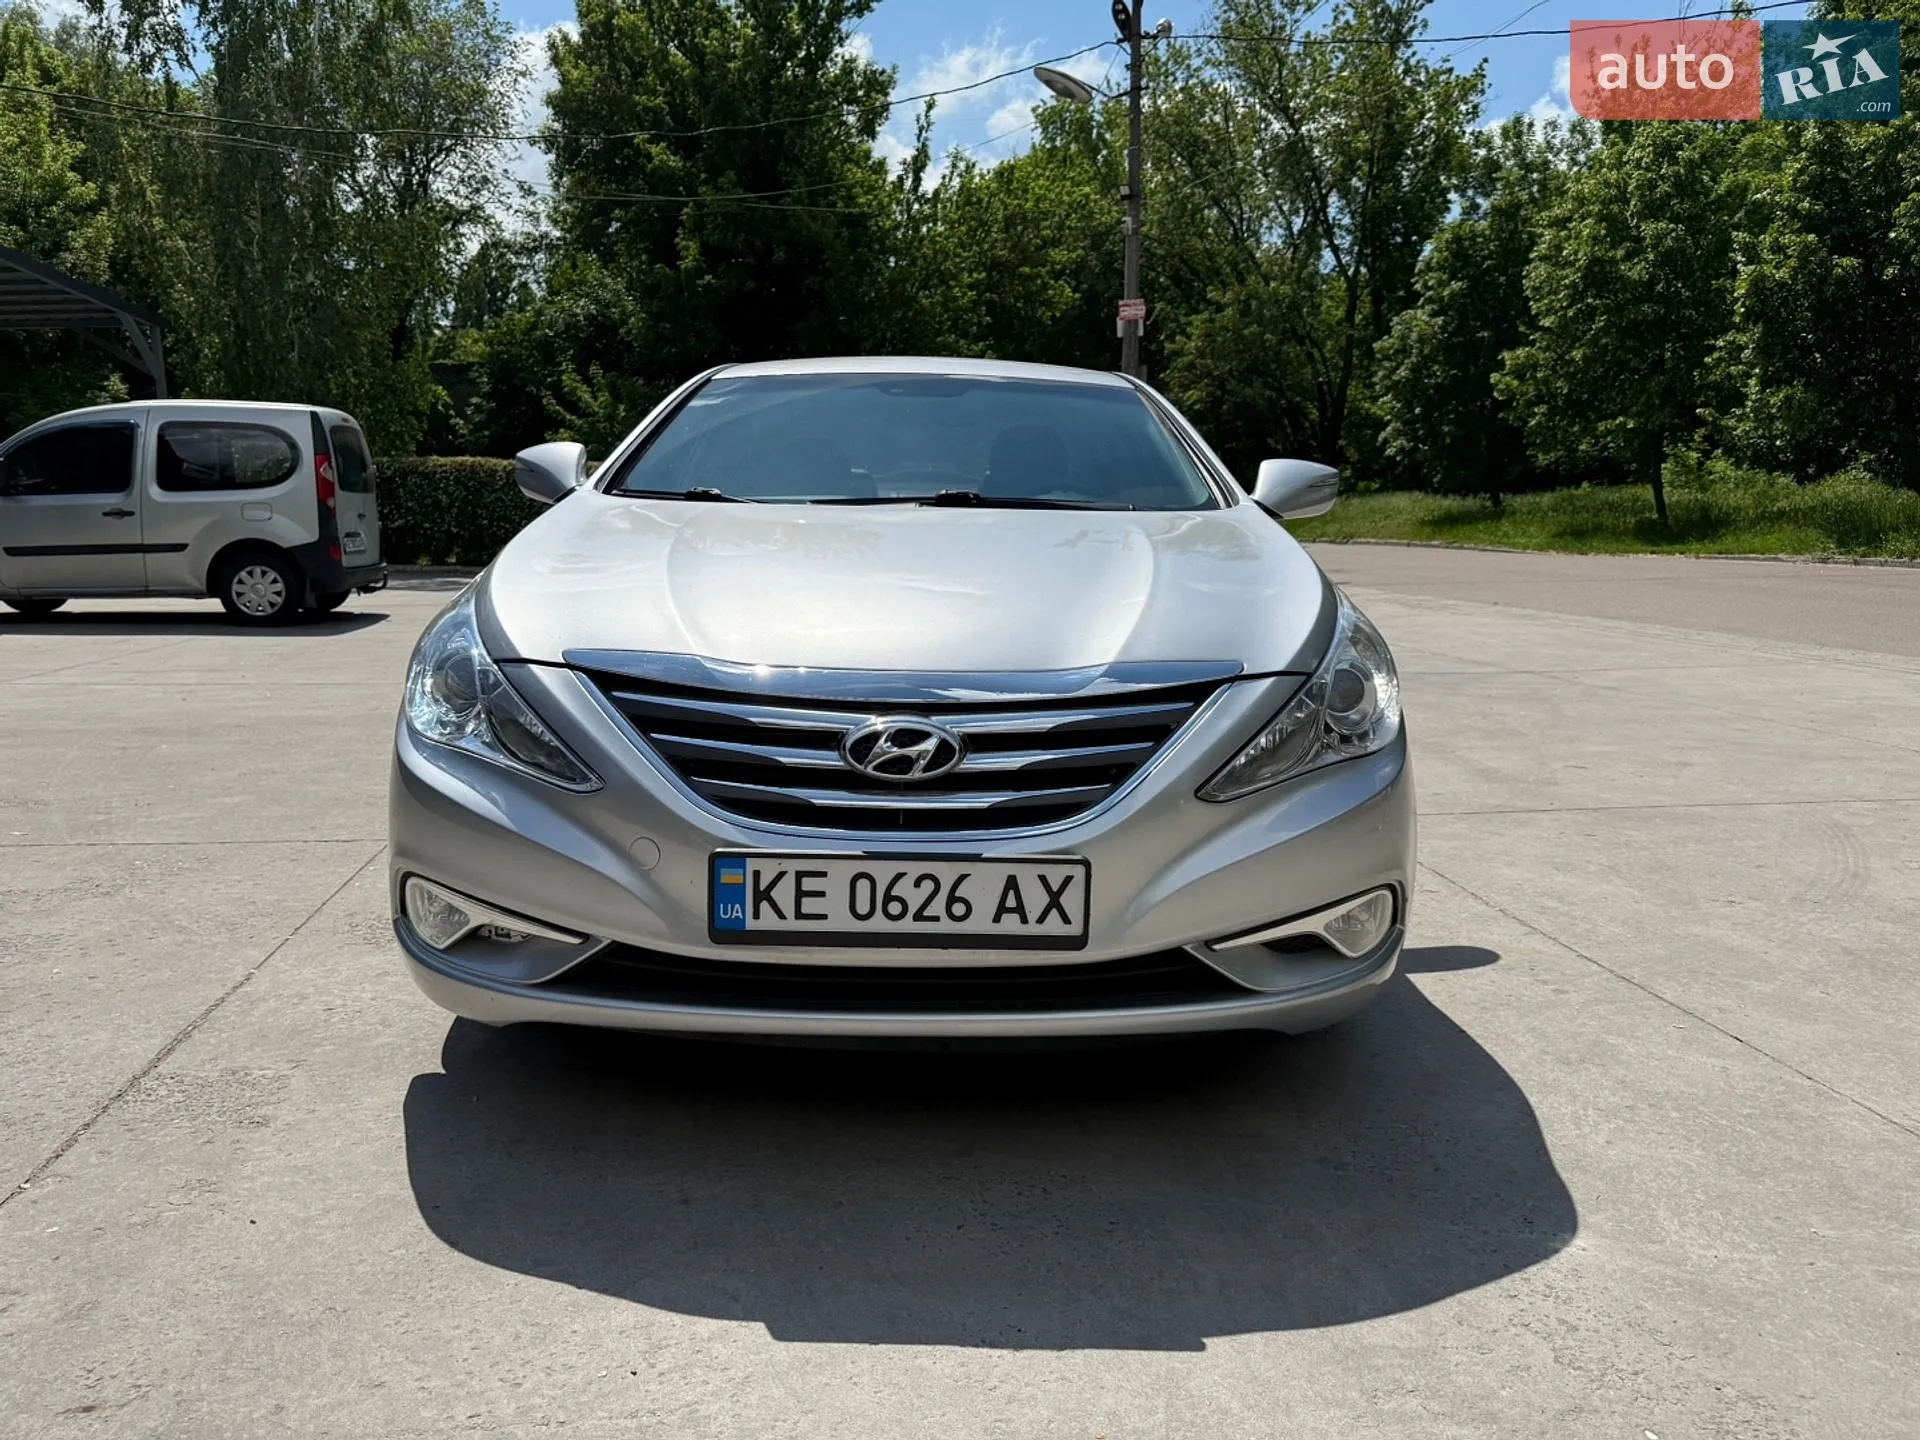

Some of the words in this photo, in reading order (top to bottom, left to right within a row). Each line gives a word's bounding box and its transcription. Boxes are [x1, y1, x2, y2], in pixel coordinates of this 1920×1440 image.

[719, 903, 744, 920] UA
[752, 869, 828, 920] KE
[848, 871, 972, 922] 0626
[991, 874, 1075, 925] AX
